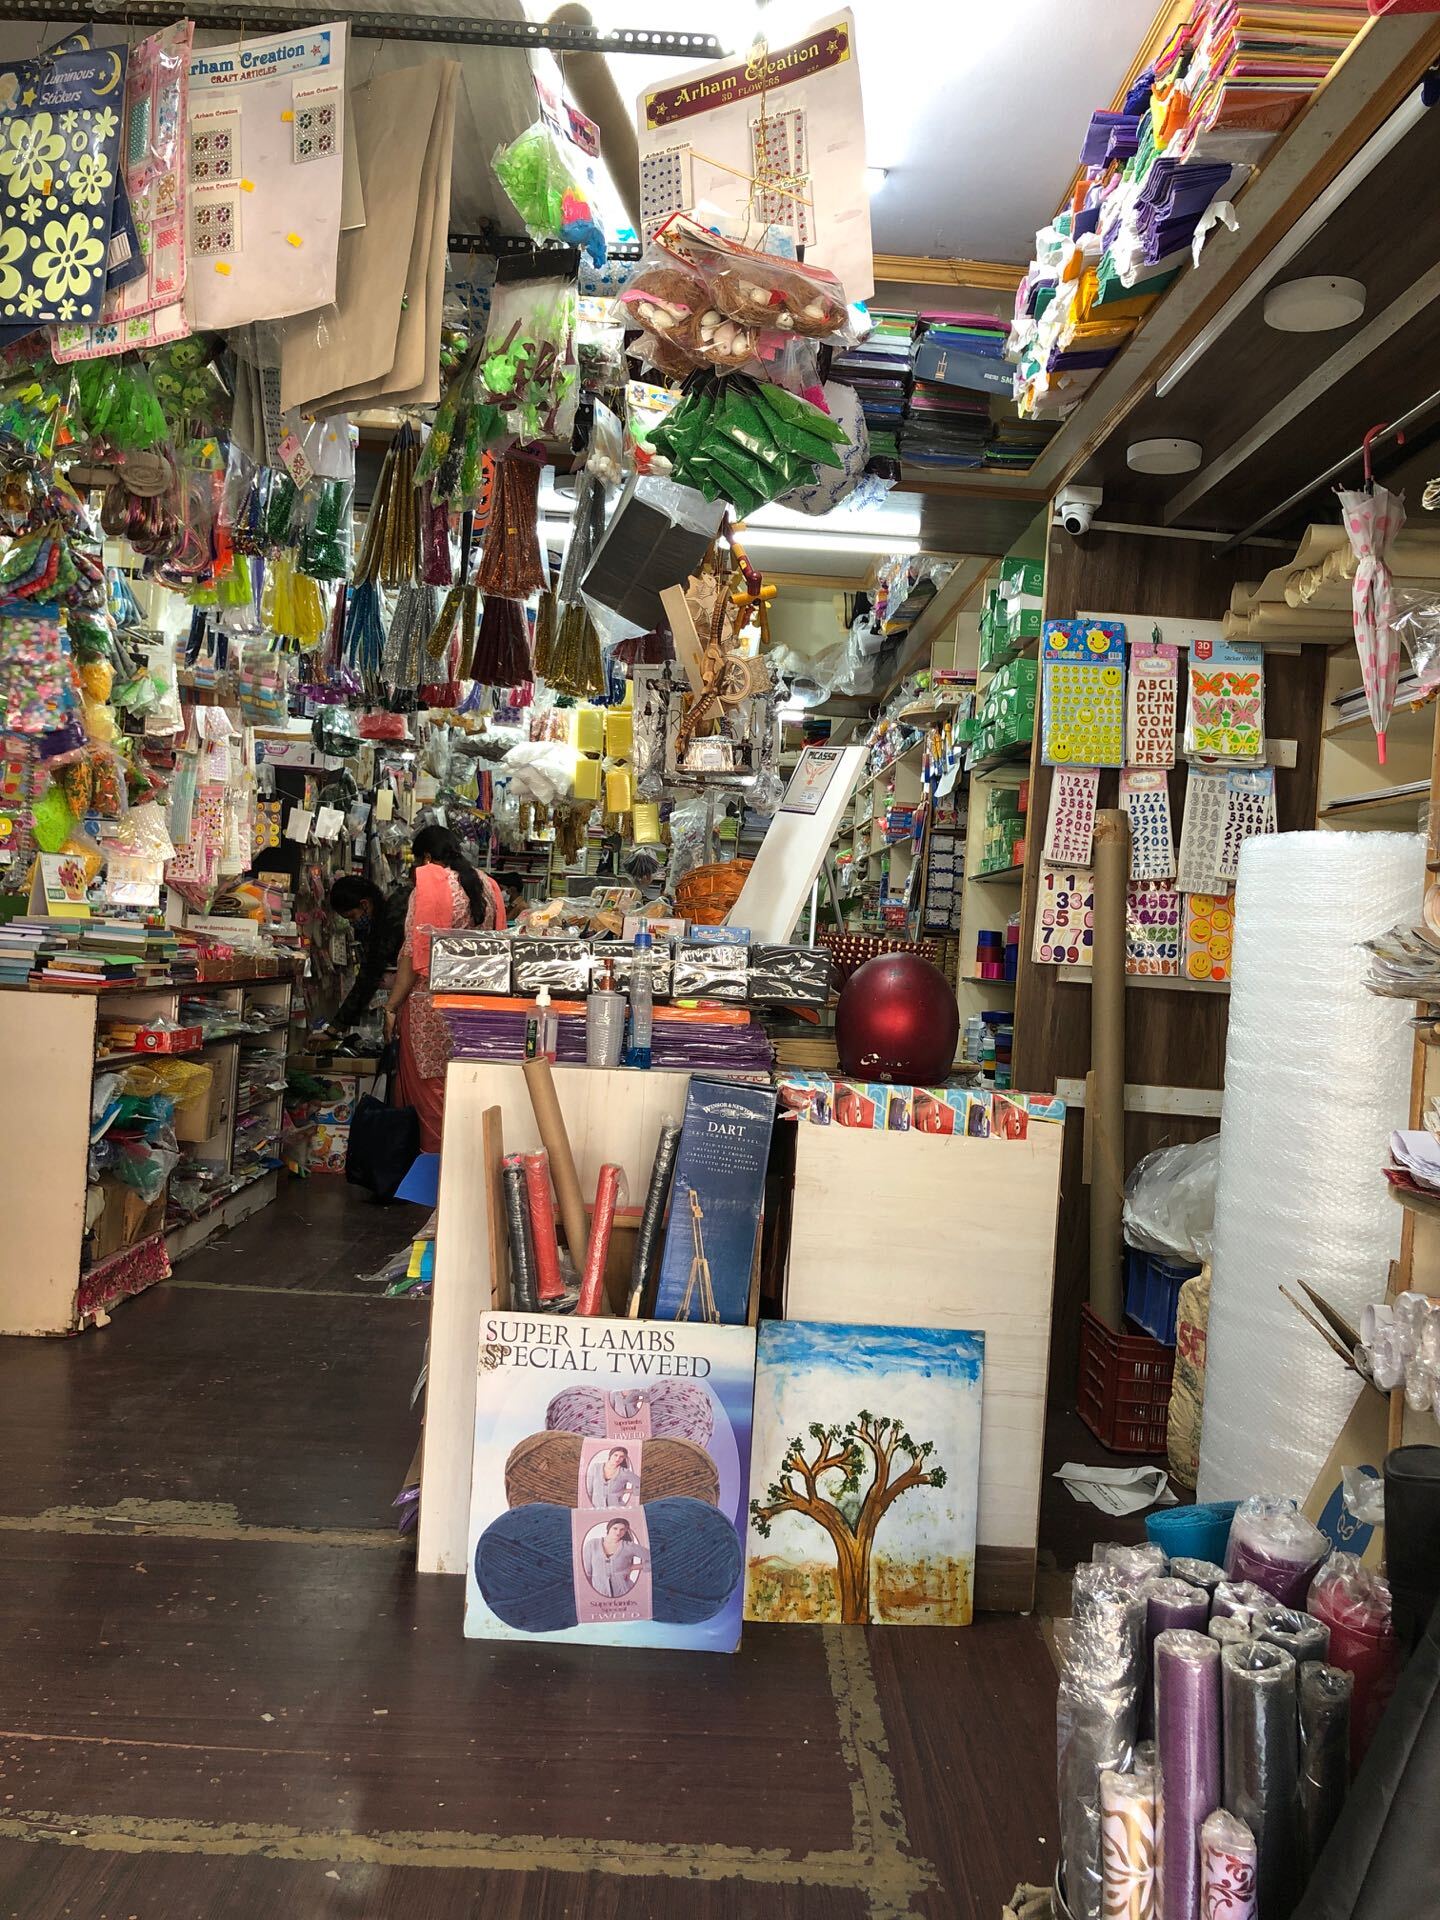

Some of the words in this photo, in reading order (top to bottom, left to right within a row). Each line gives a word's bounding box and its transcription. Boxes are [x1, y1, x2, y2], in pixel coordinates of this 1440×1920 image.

[188, 58, 234, 75] rham
[240, 44, 305, 69] Creation
[43, 68, 96, 85] Luminous
[211, 73, 238, 84] CRAFT
[240, 65, 277, 81] ARTICLES
[673, 76, 737, 106] Arham
[744, 43, 819, 82] Creation
[40, 90, 82, 106] Stickers
[296, 90, 315, 98] Arham
[316, 85, 338, 94] Creation
[194, 111, 214, 120] Arham
[215, 109, 238, 117] Creation
[216, 182, 238, 190] Creation
[1197, 641, 1210, 651] 3D
[807, 751, 838, 761] PICASSO
[707, 1121, 747, 1136] DART
[486, 1320, 571, 1349] SUPER
[580, 1327, 675, 1352] LAMBS
[485, 1343, 598, 1372] SPECIAL
[606, 1352, 711, 1378] TWEED
